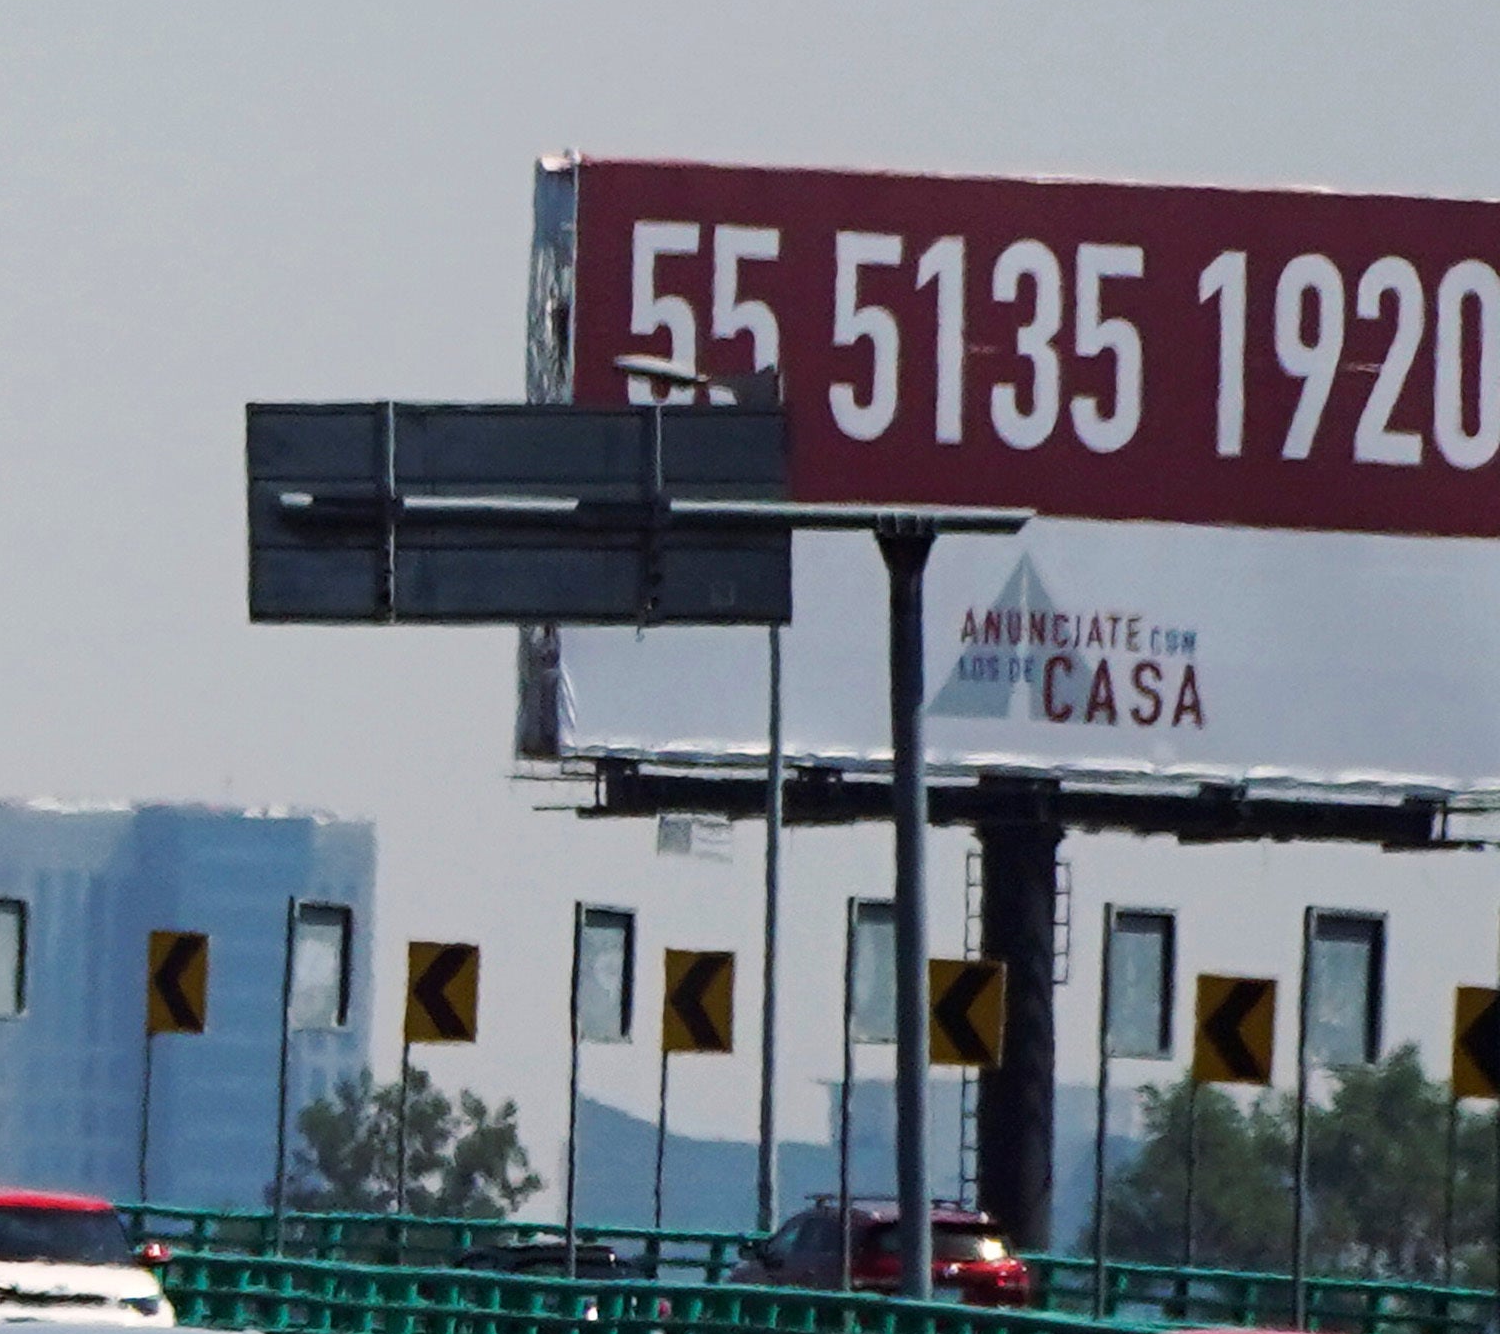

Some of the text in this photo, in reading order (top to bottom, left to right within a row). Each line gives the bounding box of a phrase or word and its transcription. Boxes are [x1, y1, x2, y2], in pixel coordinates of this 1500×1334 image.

[627, 220, 1500, 471] 55 5135 1920
[1042, 655, 1205, 730] CASA
